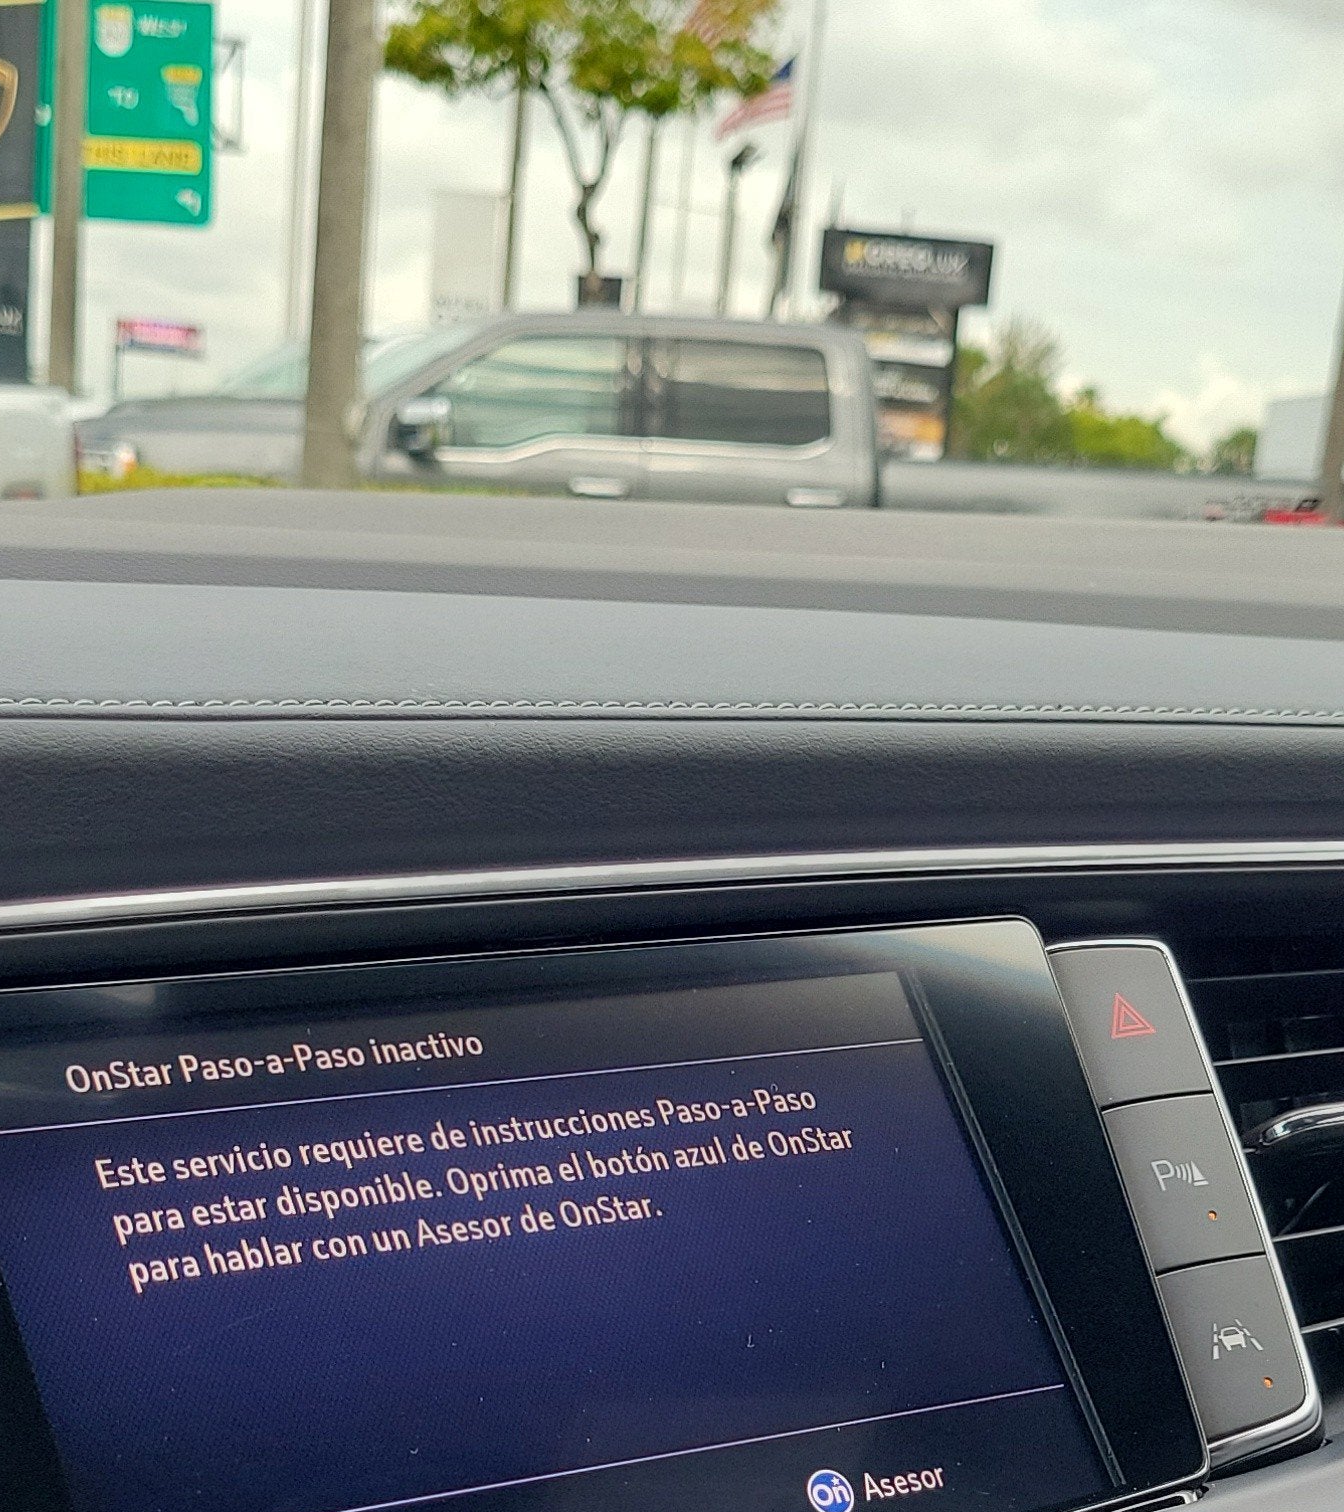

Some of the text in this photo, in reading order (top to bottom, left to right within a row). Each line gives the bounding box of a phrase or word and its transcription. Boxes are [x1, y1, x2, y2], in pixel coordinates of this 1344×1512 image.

[65, 1032, 484, 1093] OnStar Paso-a-Paso inactivo
[94, 1088, 817, 1189] Este servicio requiere de instrucciones Paso-a-Paso
[113, 1125, 853, 1246] para estar disponible. Oprima el botón azul de OnStar
[128, 1195, 664, 1294] para hablar con un Asesor de OnStar.
[863, 1464, 945, 1501] Asesor
